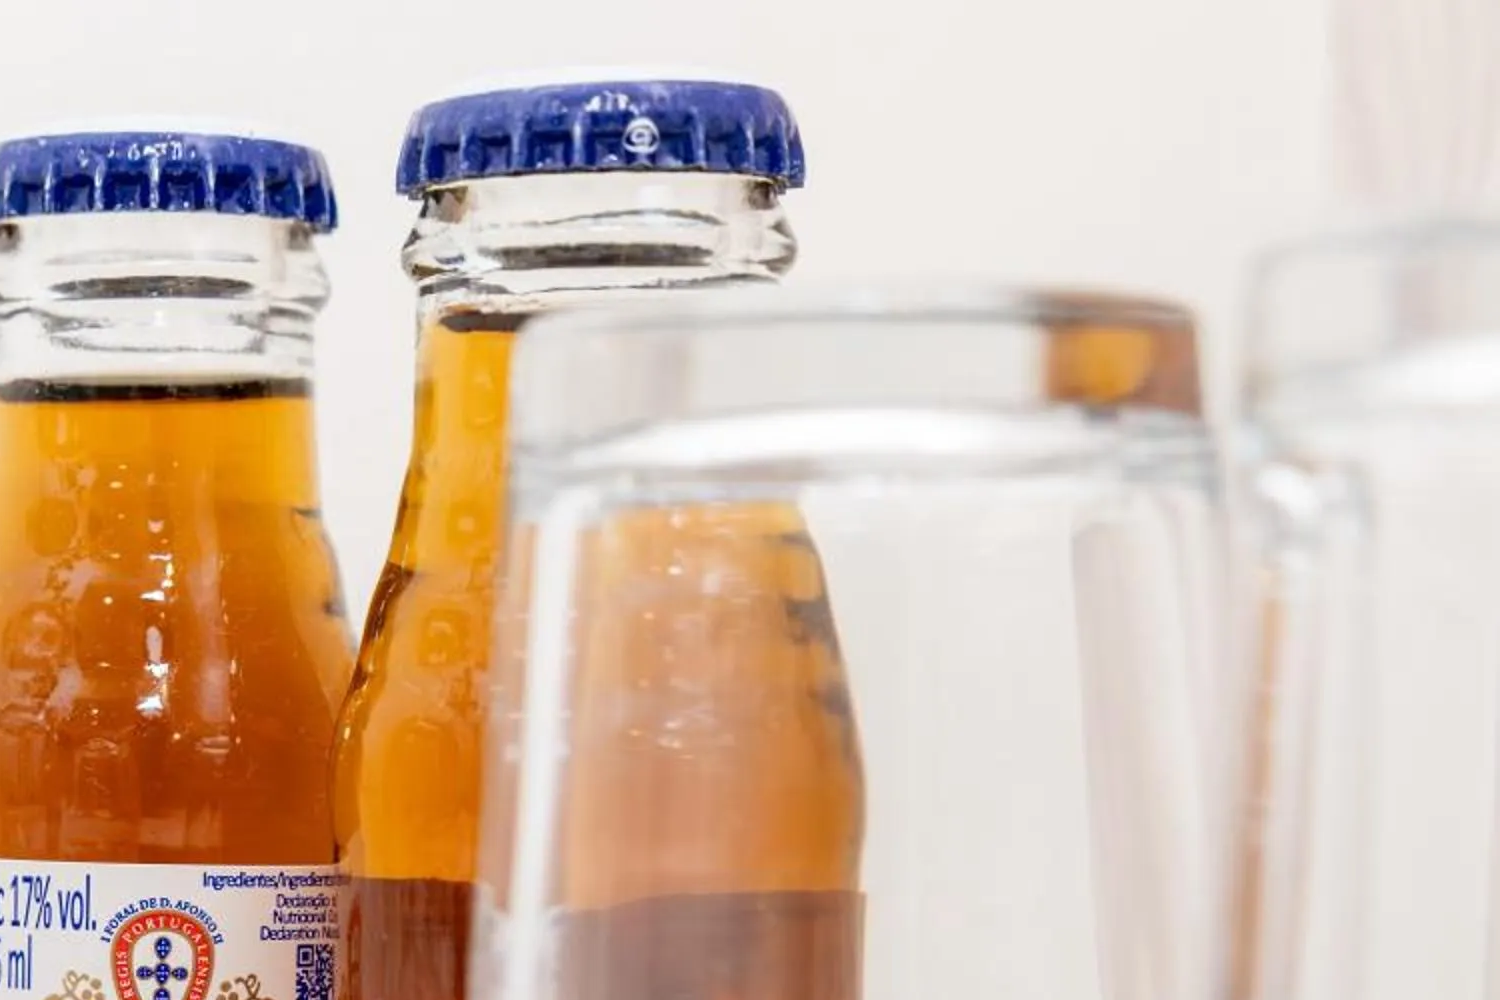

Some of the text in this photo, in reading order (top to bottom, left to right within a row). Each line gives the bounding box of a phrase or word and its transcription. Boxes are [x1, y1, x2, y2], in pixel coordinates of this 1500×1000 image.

[11, 874, 52, 929] 17%
[58, 873, 97, 931] vol.
[104, 904, 139, 936] FORAL
[139, 898, 158, 910] DE
[160, 897, 173, 909] D.
[175, 900, 218, 933] AFONSO
[8, 934, 32, 990] ml
[115, 950, 135, 999] REGIS
